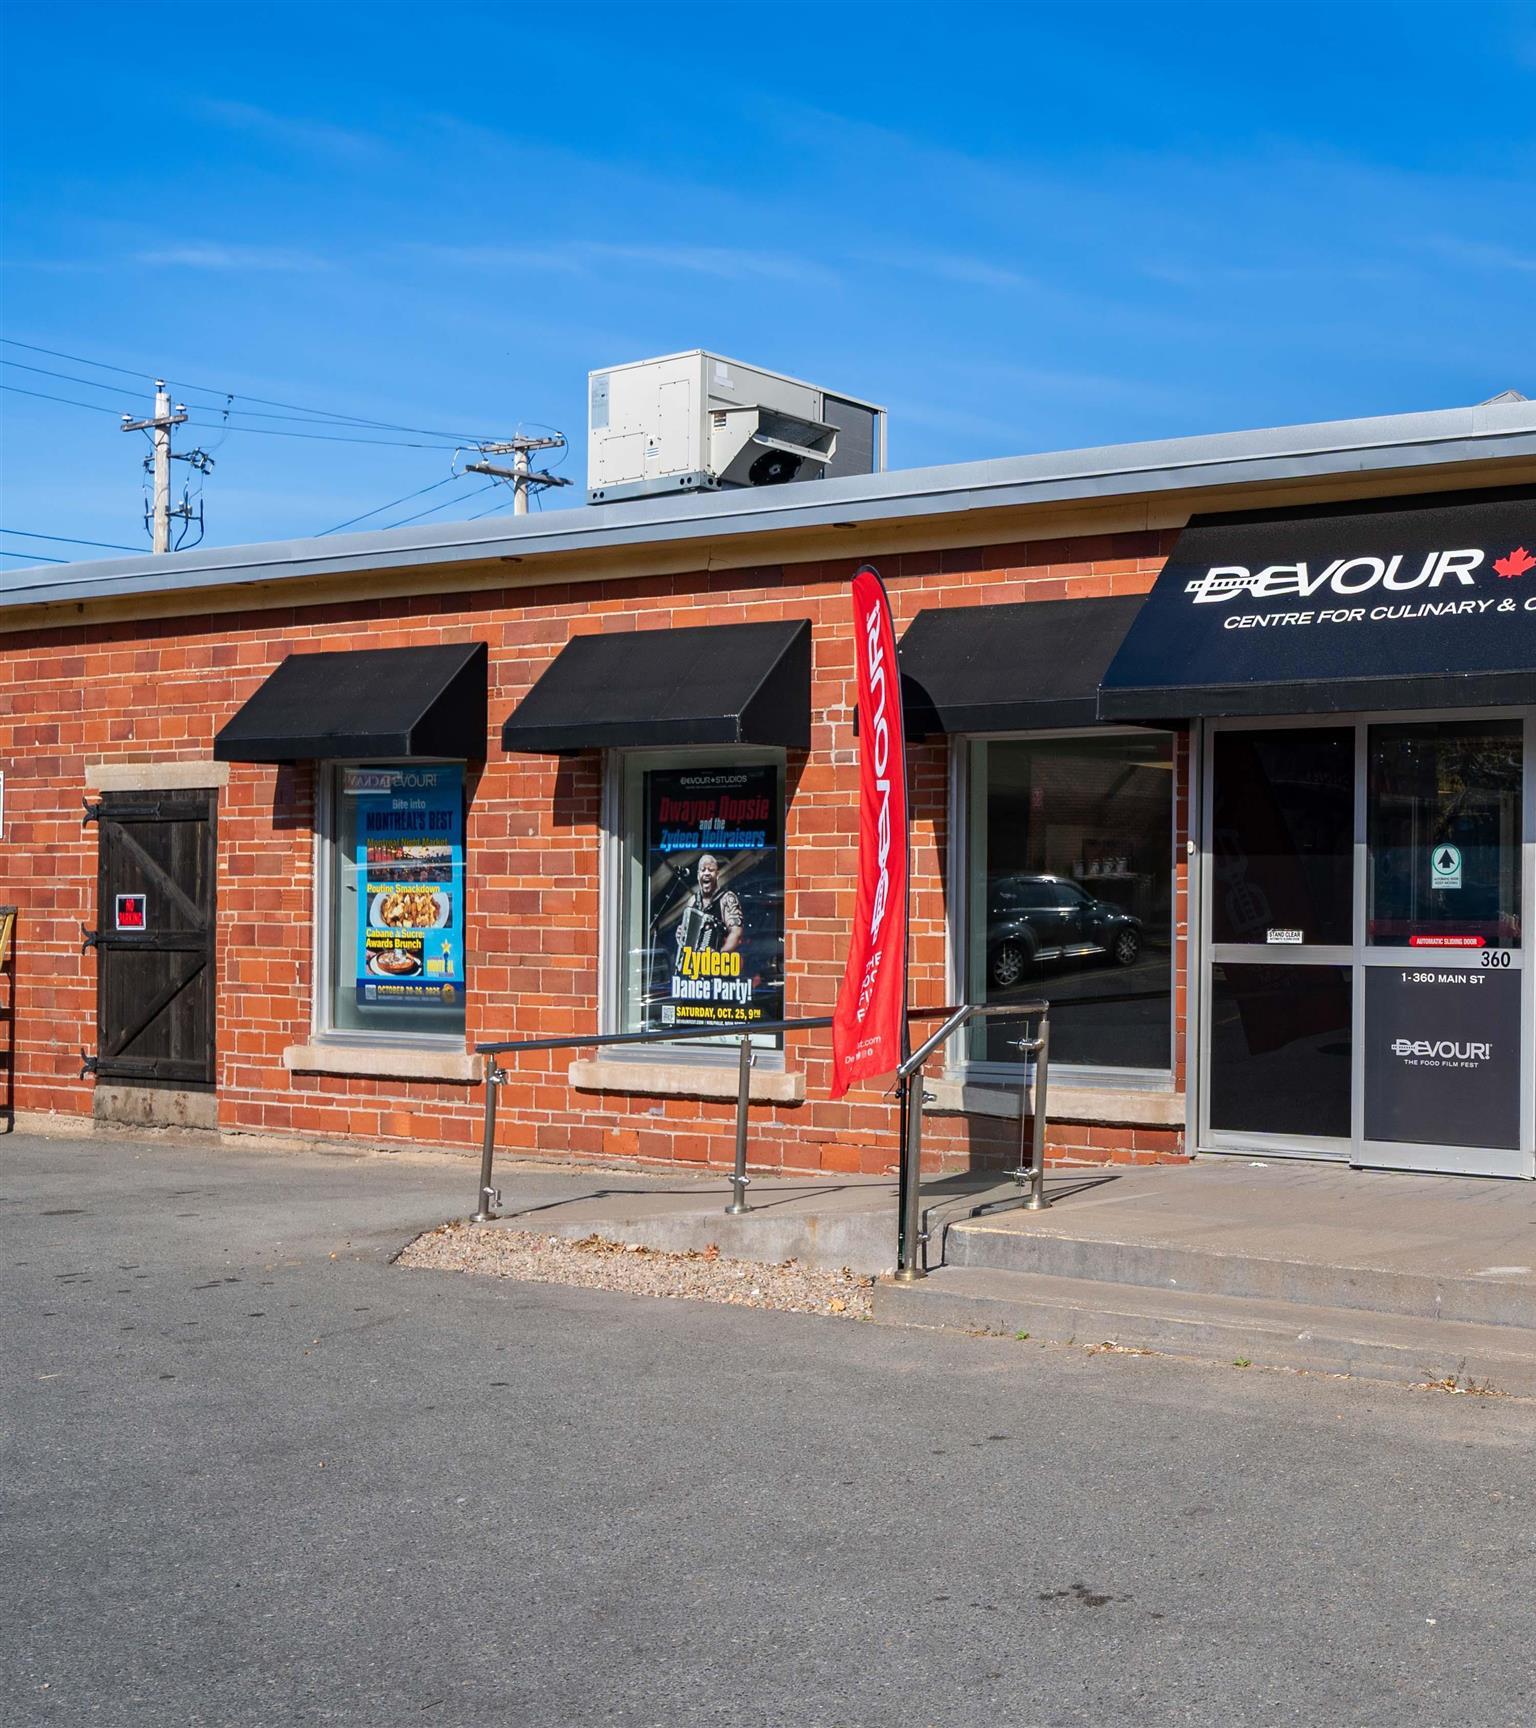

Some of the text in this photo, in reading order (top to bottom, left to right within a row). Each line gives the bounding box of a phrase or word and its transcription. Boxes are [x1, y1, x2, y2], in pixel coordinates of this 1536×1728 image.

[1184, 549, 1485, 603] DEVOUR
[1223, 611, 1314, 629] CENTRE
[1317, 608, 1366, 624] FOR
[1370, 598, 1495, 620] CULINARY
[1497, 598, 1516, 611] &
[715, 775, 748, 784] STUDIOS
[392, 799, 425, 809] Bite into
[659, 795, 769, 825] Dwayne Dopsie
[428, 810, 453, 831] BEST
[699, 818, 726, 831] and the
[660, 828, 766, 852] Zydeco Hellraisers
[367, 884, 440, 893] Poutine Smackdown
[125, 898, 135, 912] NO
[366, 928, 393, 938] Cabane
[366, 939, 421, 949] Awards Brunch
[682, 946, 741, 980] Zydeco
[1481, 951, 1511, 967] 360
[1401, 972, 1485, 984] 1-360 MAIN ST
[672, 976, 752, 1005] Dance Party!
[676, 1006, 716, 1019] SATURDAY,
[717, 1007, 734, 1018] OCT.
[735, 1008, 747, 1020] 25,
[1391, 1039, 1490, 1060] DEVOUR!
